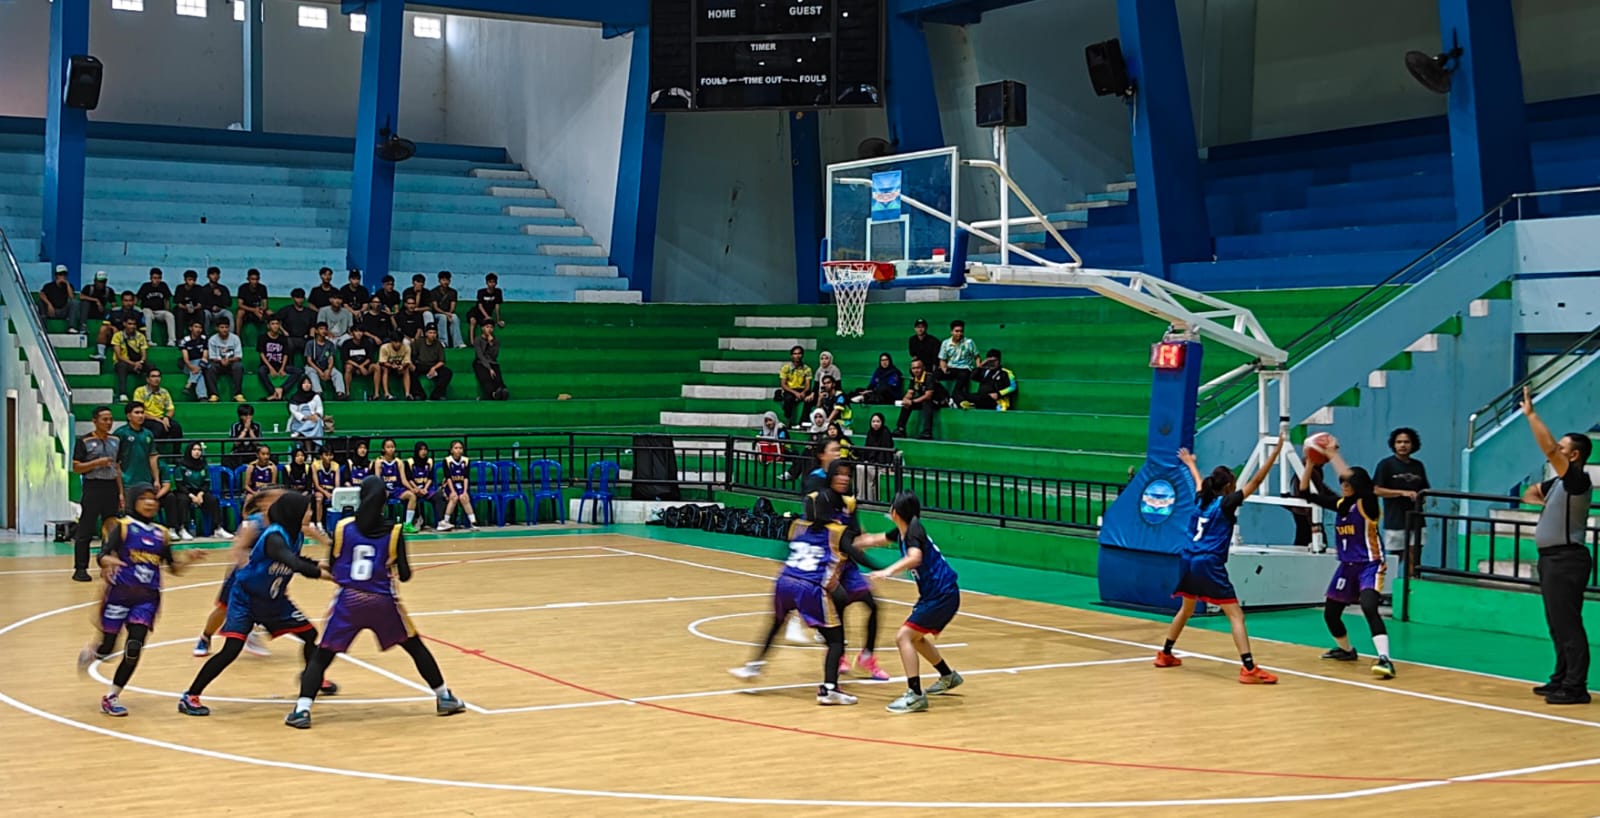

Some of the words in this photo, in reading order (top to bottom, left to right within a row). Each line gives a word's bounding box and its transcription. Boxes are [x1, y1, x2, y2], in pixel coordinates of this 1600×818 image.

[708, 9, 736, 19] HOME
[789, 6, 823, 16] GUEST
[750, 43, 776, 51] TIMER
[744, 76, 763, 84] TIME
[765, 76, 782, 84] OUT
[800, 74, 827, 83] FOULS
[1192, 516, 1209, 542] 5
[350, 544, 376, 580] 6
